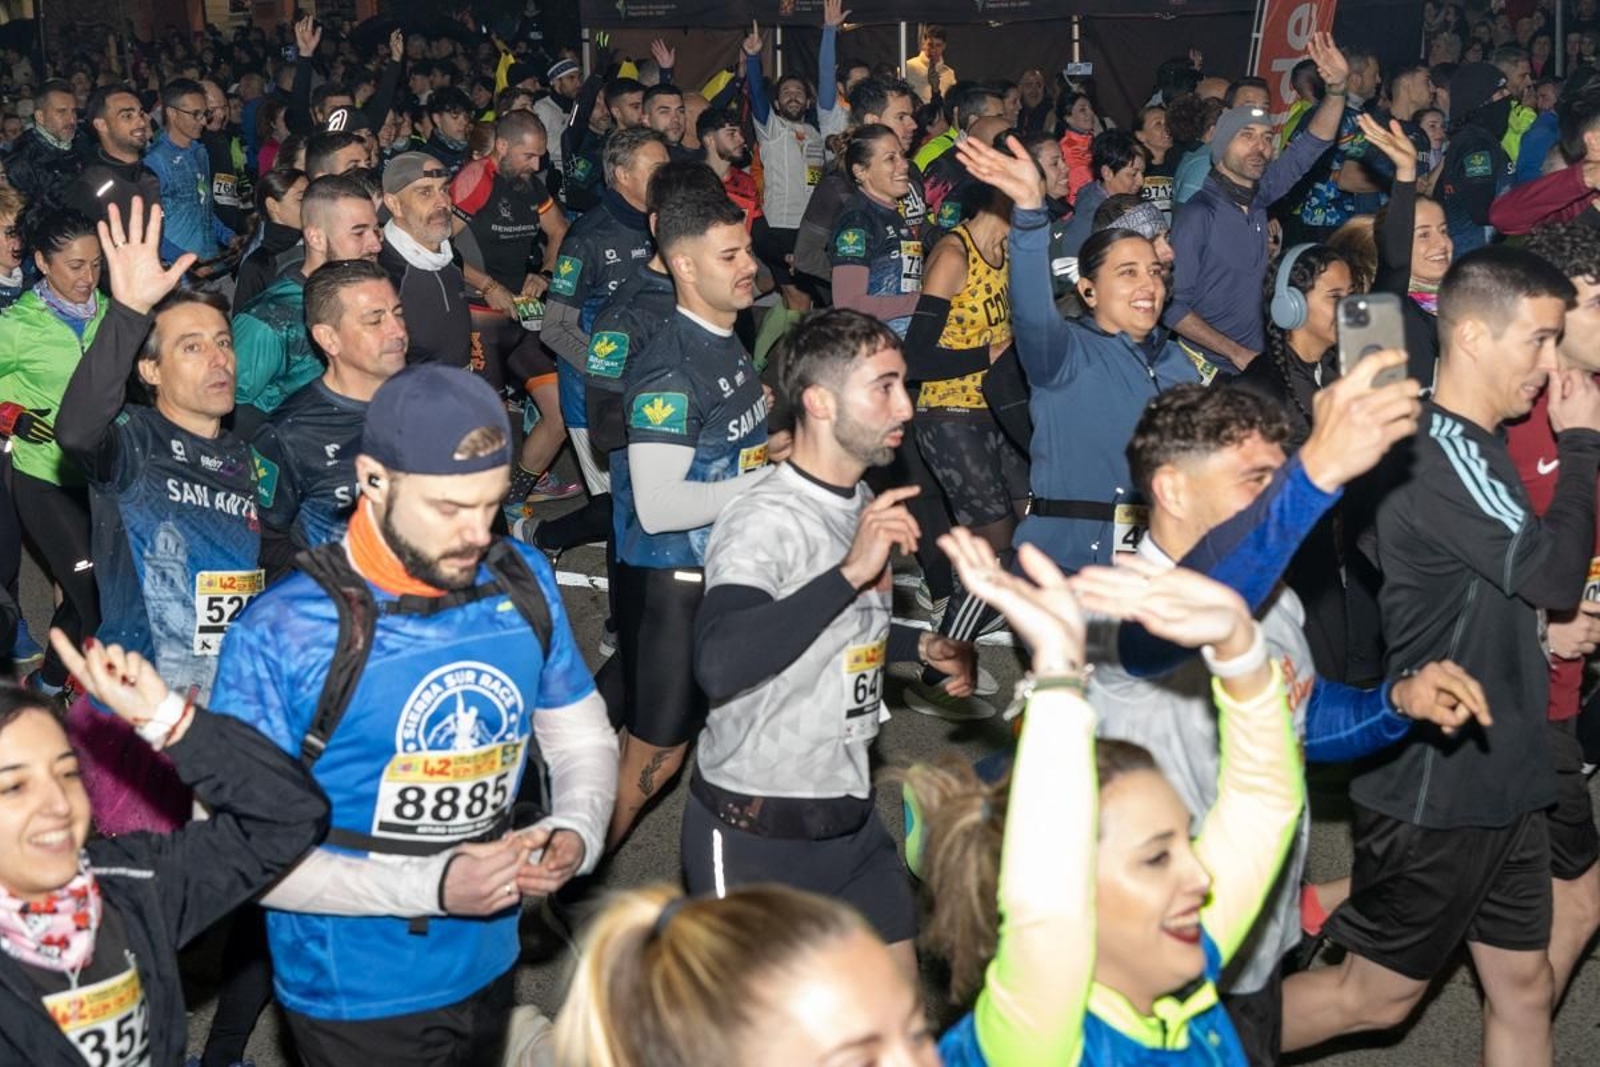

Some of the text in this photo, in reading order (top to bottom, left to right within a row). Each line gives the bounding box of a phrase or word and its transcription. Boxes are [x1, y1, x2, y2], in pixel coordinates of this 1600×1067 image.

[167, 478, 210, 508] SAN
[206, 595, 254, 623] 52
[403, 669, 517, 739] SIERRA SUR RACE
[394, 771, 509, 821] 8885
